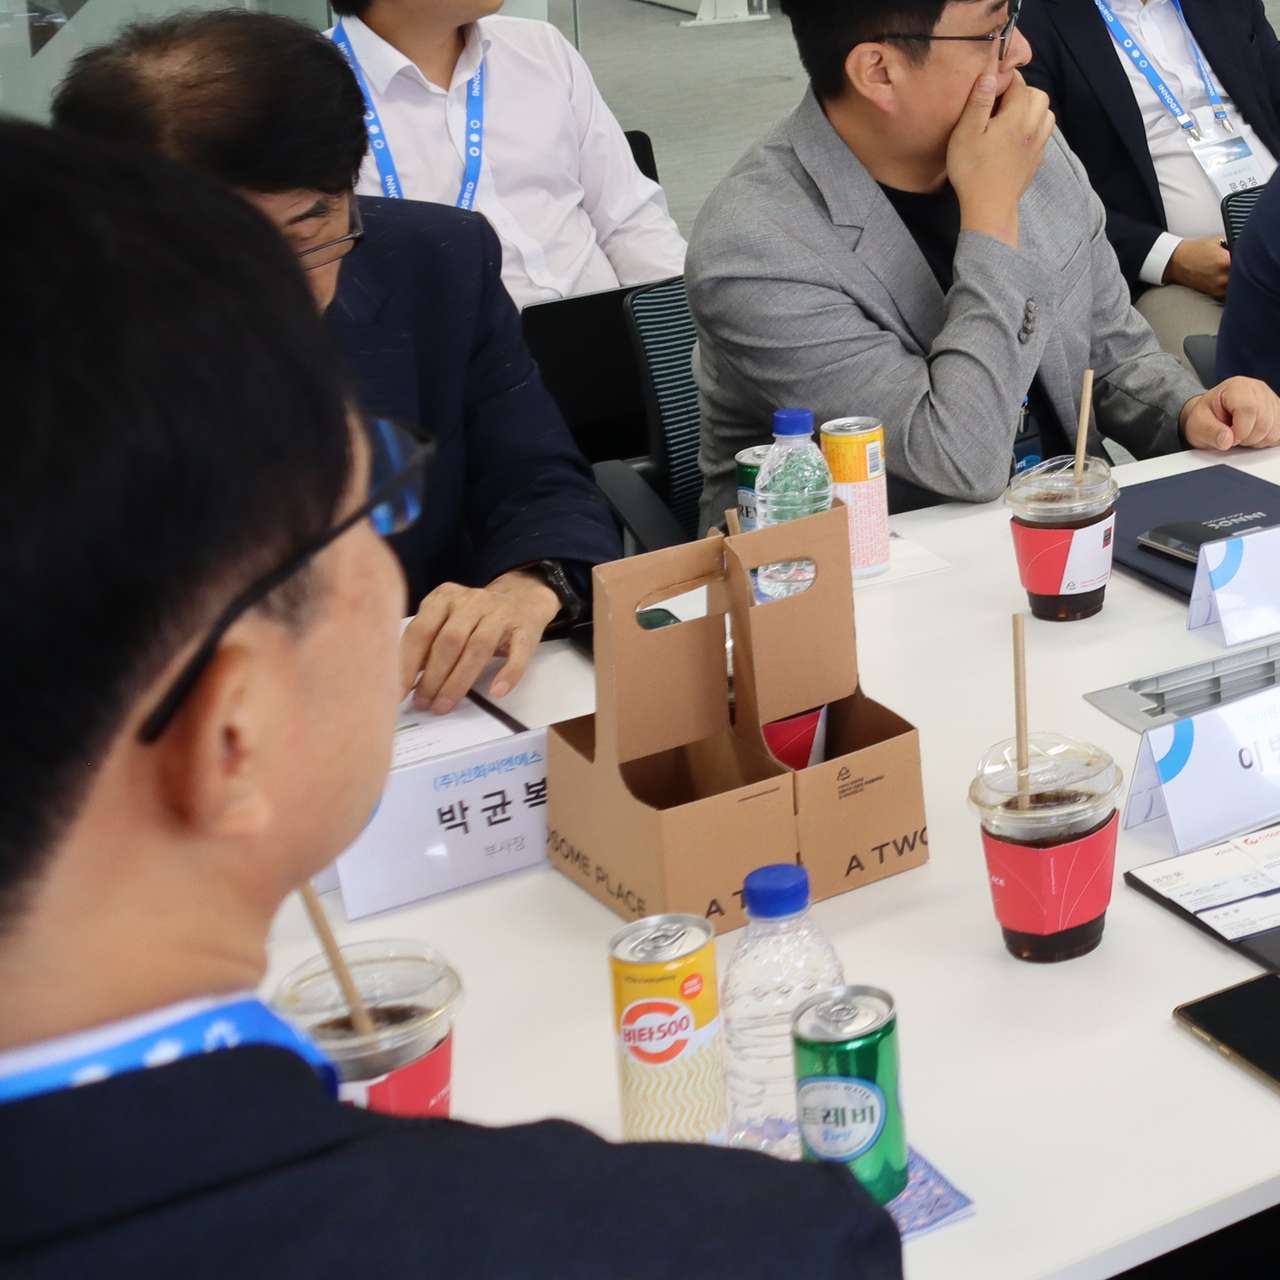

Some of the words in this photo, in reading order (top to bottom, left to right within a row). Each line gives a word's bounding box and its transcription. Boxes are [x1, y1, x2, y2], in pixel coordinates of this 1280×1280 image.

[1158, 83, 1183, 116] INNOGRI
[844, 856, 865, 877] A
[594, 856, 648, 916] PLACE
[704, 897, 726, 920] A
[622, 1015, 690, 1043] 비타500
[801, 1104, 875, 1128] 트레비
